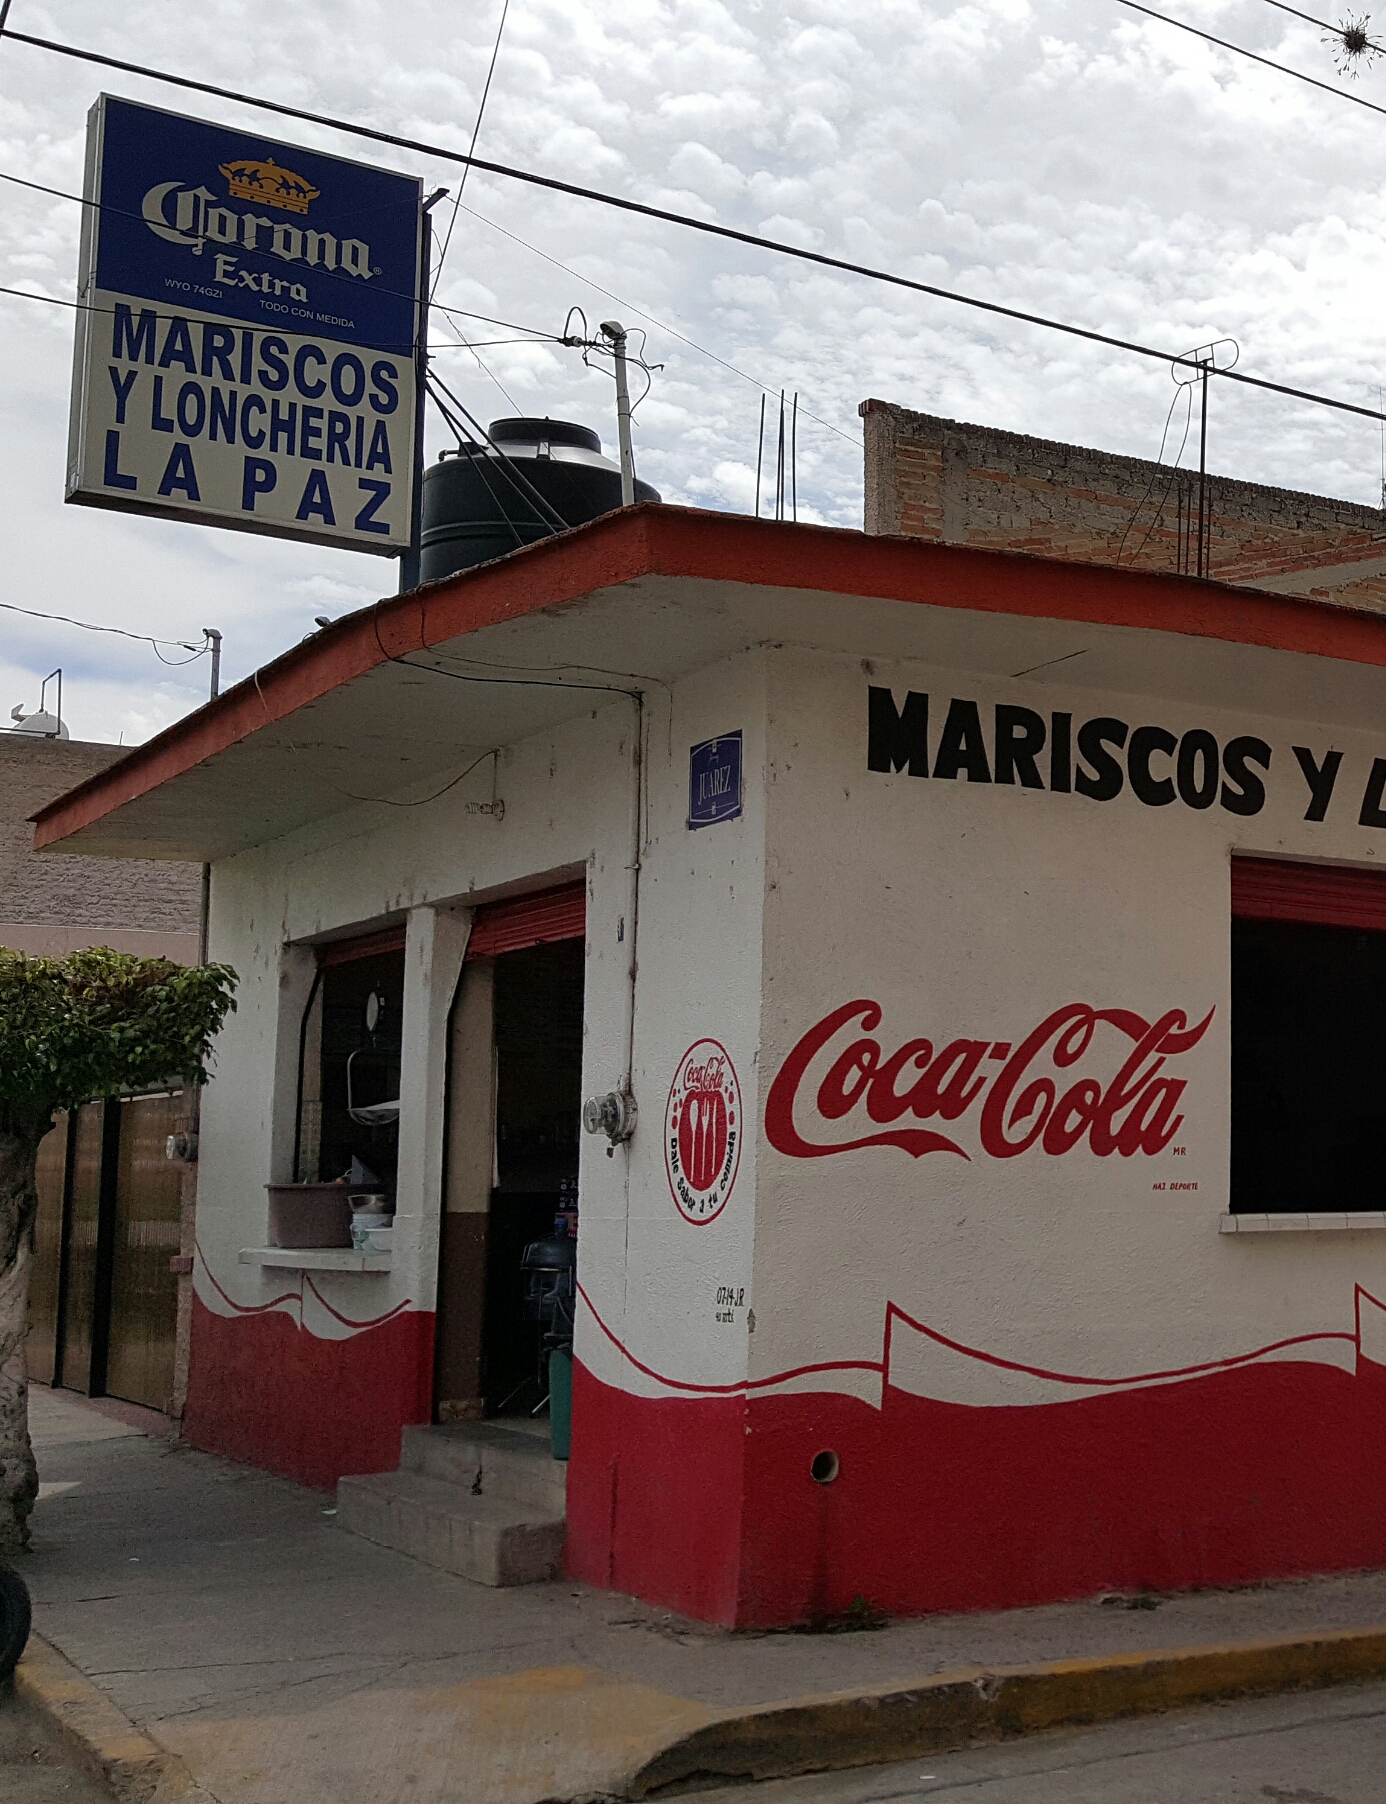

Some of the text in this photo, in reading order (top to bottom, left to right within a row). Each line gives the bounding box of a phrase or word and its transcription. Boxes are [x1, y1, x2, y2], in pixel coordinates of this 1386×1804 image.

[142, 181, 374, 280] Corona
[164, 278, 190, 292] WYO
[213, 253, 309, 303] Extra
[259, 300, 355, 329] TODO CON MEDIDA
[112, 303, 399, 415] MARISCOS
[109, 365, 393, 475] Y LONCHERIA
[103, 430, 391, 535] LA PAZ
[698, 765, 731, 805] JUAREZ
[868, 685, 1272, 816] MARISCOS
[1291, 746, 1344, 822] Y
[765, 999, 1216, 1161] Coca-Cola
[1153, 1182, 1198, 1190] HAZ DEPORTE
[1173, 1146, 1186, 1155] MR
